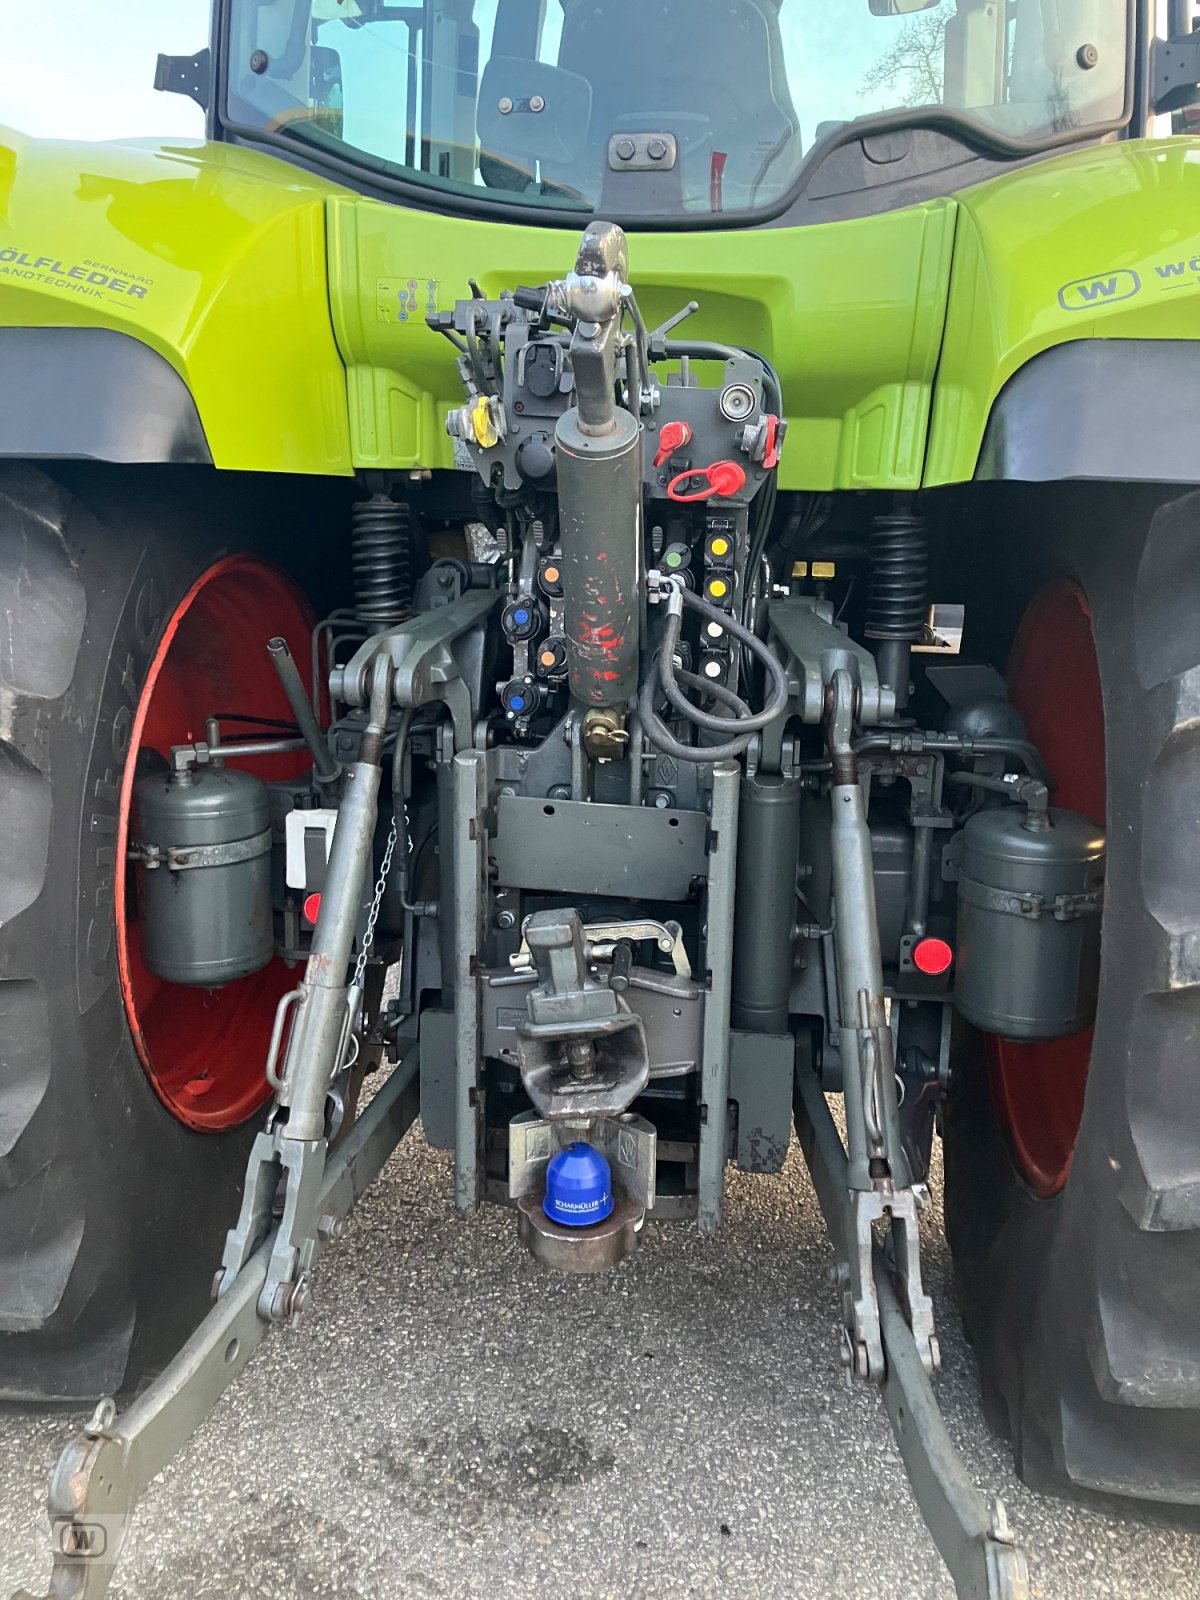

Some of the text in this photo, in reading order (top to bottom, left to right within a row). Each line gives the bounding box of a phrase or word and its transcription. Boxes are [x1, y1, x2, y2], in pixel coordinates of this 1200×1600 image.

[0, 266, 106, 298] ANDTECHNIK
[83, 259, 154, 286] BERNHARD
[1077, 277, 1117, 301] W
